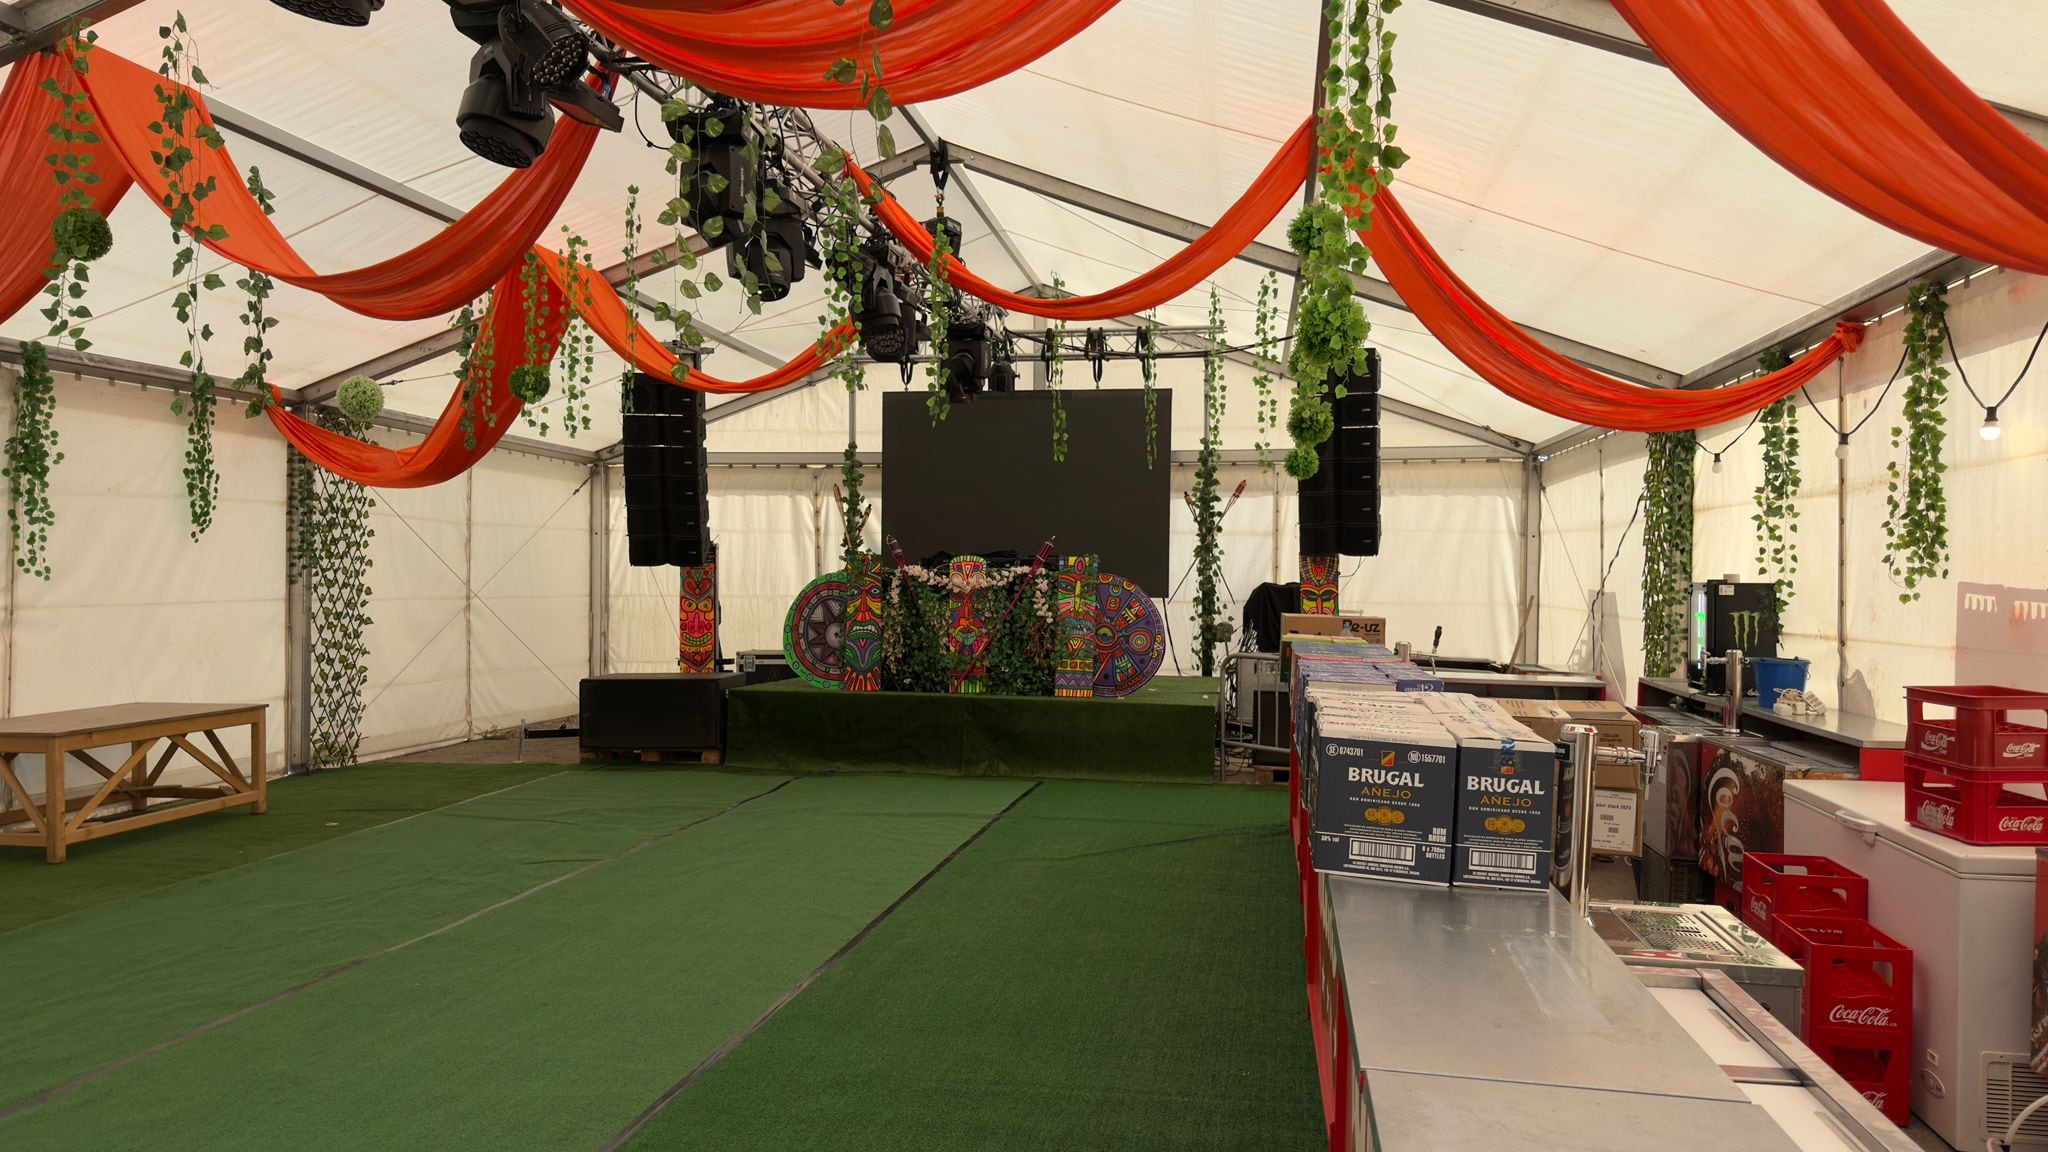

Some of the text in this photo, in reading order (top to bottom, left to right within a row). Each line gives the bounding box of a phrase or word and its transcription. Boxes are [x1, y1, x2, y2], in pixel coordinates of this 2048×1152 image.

[2005, 742, 2037, 753] Coca-Cola
[1421, 753, 1446, 764] 1557701
[1348, 766, 1425, 788] BRUGAL
[1466, 775, 1545, 795] BRUGAL
[1361, 786, 1412, 799] AÑEJO
[1480, 795, 1532, 807] AÑEJO
[1999, 816, 2045, 832] Coca-Cola
[1829, 1004, 1892, 1027] Coca-Cola
